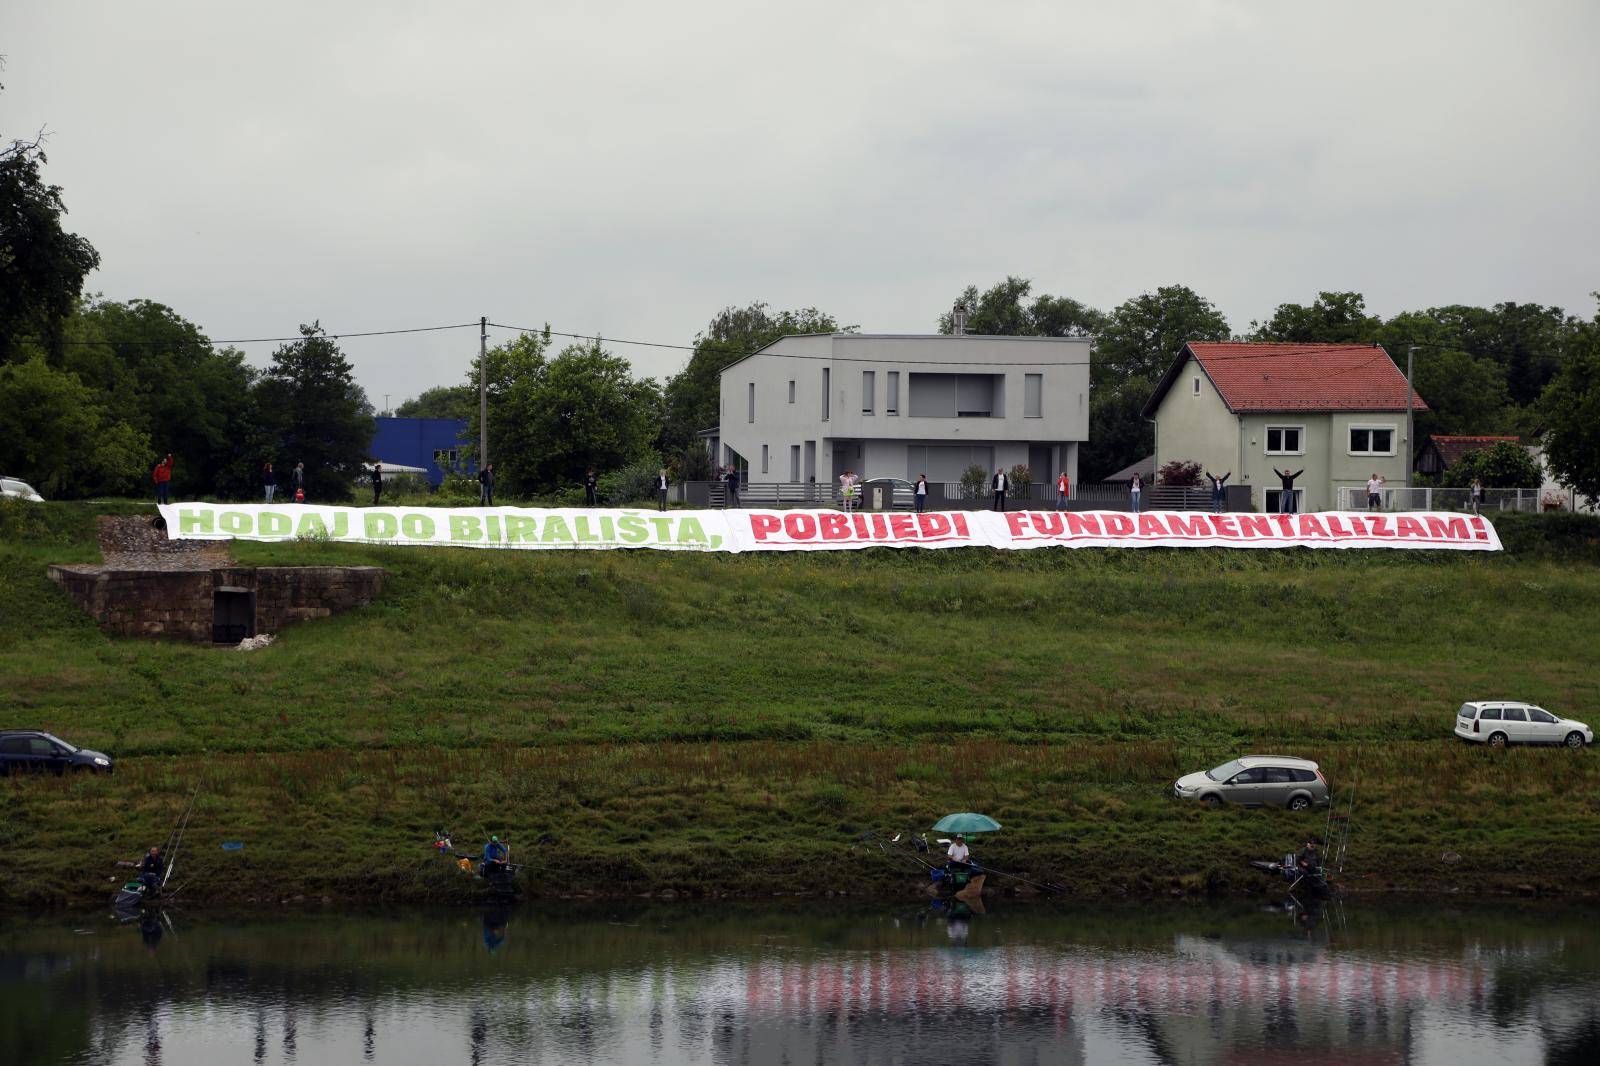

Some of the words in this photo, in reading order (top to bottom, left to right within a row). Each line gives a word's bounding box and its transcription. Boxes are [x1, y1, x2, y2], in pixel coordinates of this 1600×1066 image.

[179, 509, 350, 538] HODAJ
[363, 513, 436, 540] DO
[449, 512, 723, 548] BIRALIŠTA,
[749, 513, 970, 541] POBIJEDI
[1003, 512, 1489, 541] FUNDAMENTALIZAM!
